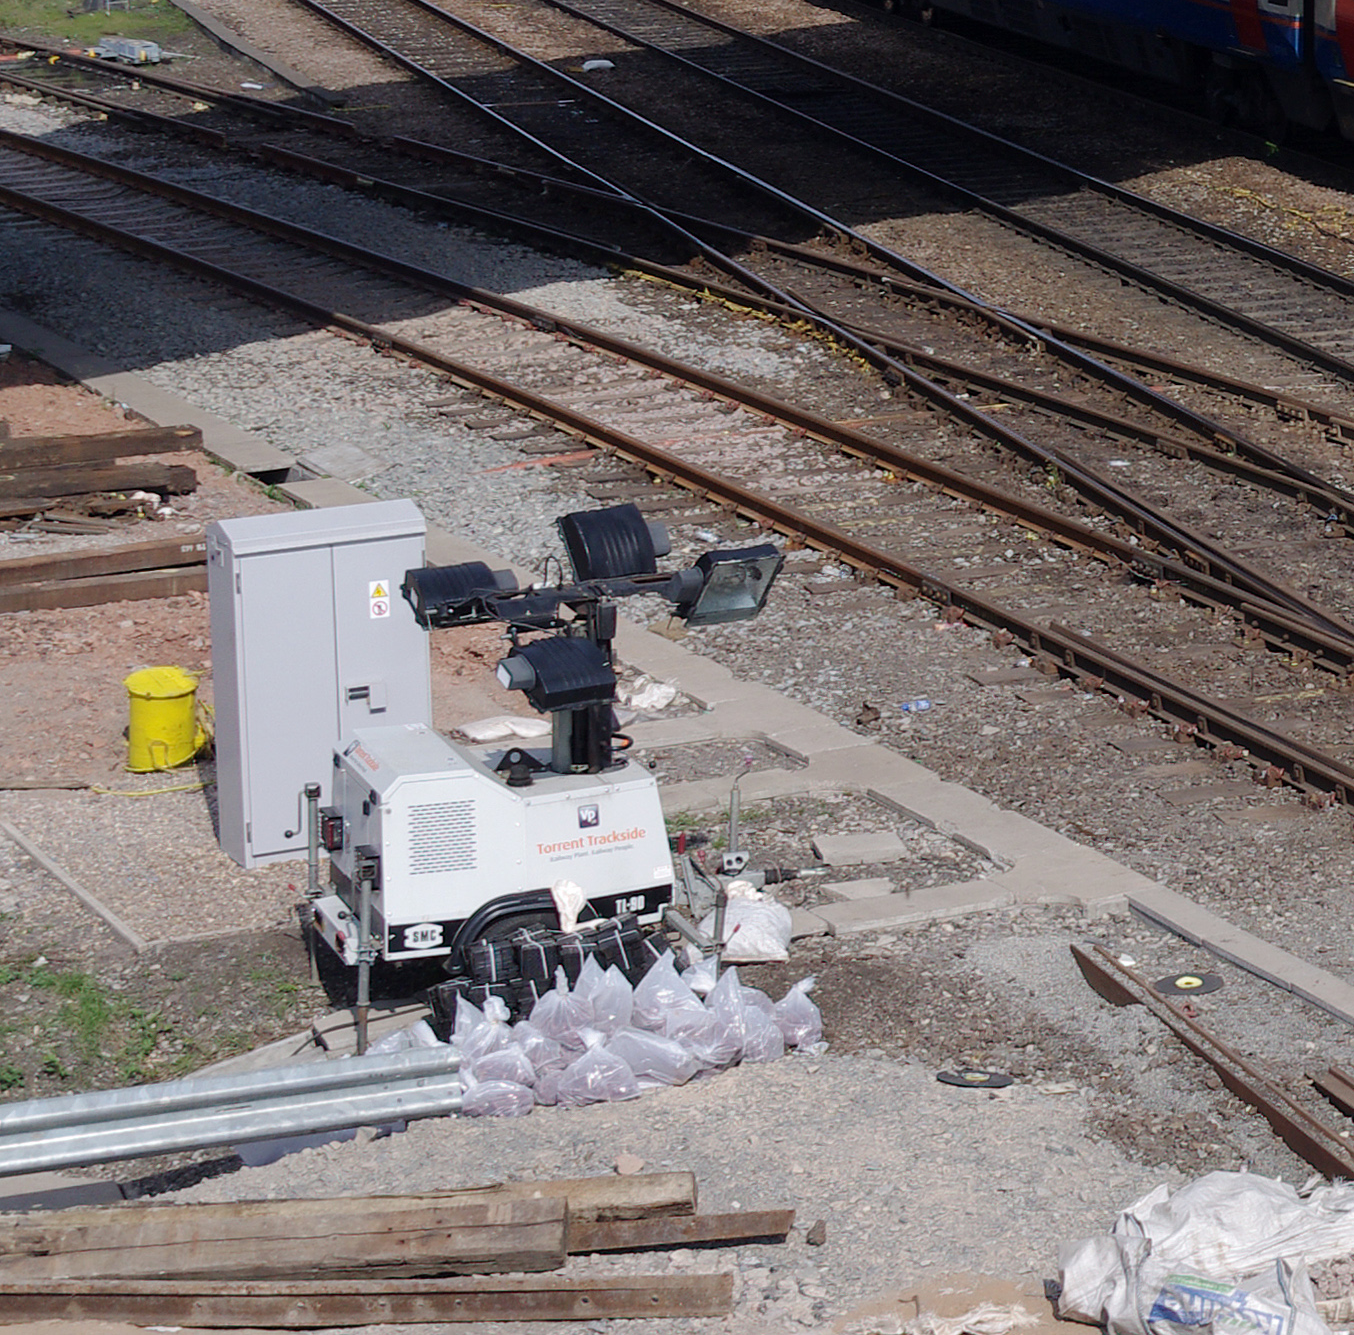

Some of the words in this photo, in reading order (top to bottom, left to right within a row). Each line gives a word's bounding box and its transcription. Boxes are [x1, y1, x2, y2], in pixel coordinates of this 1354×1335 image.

[537, 837, 584, 855] Torrent
[586, 827, 646, 846] Trackside
[413, 930, 437, 943] SMC
